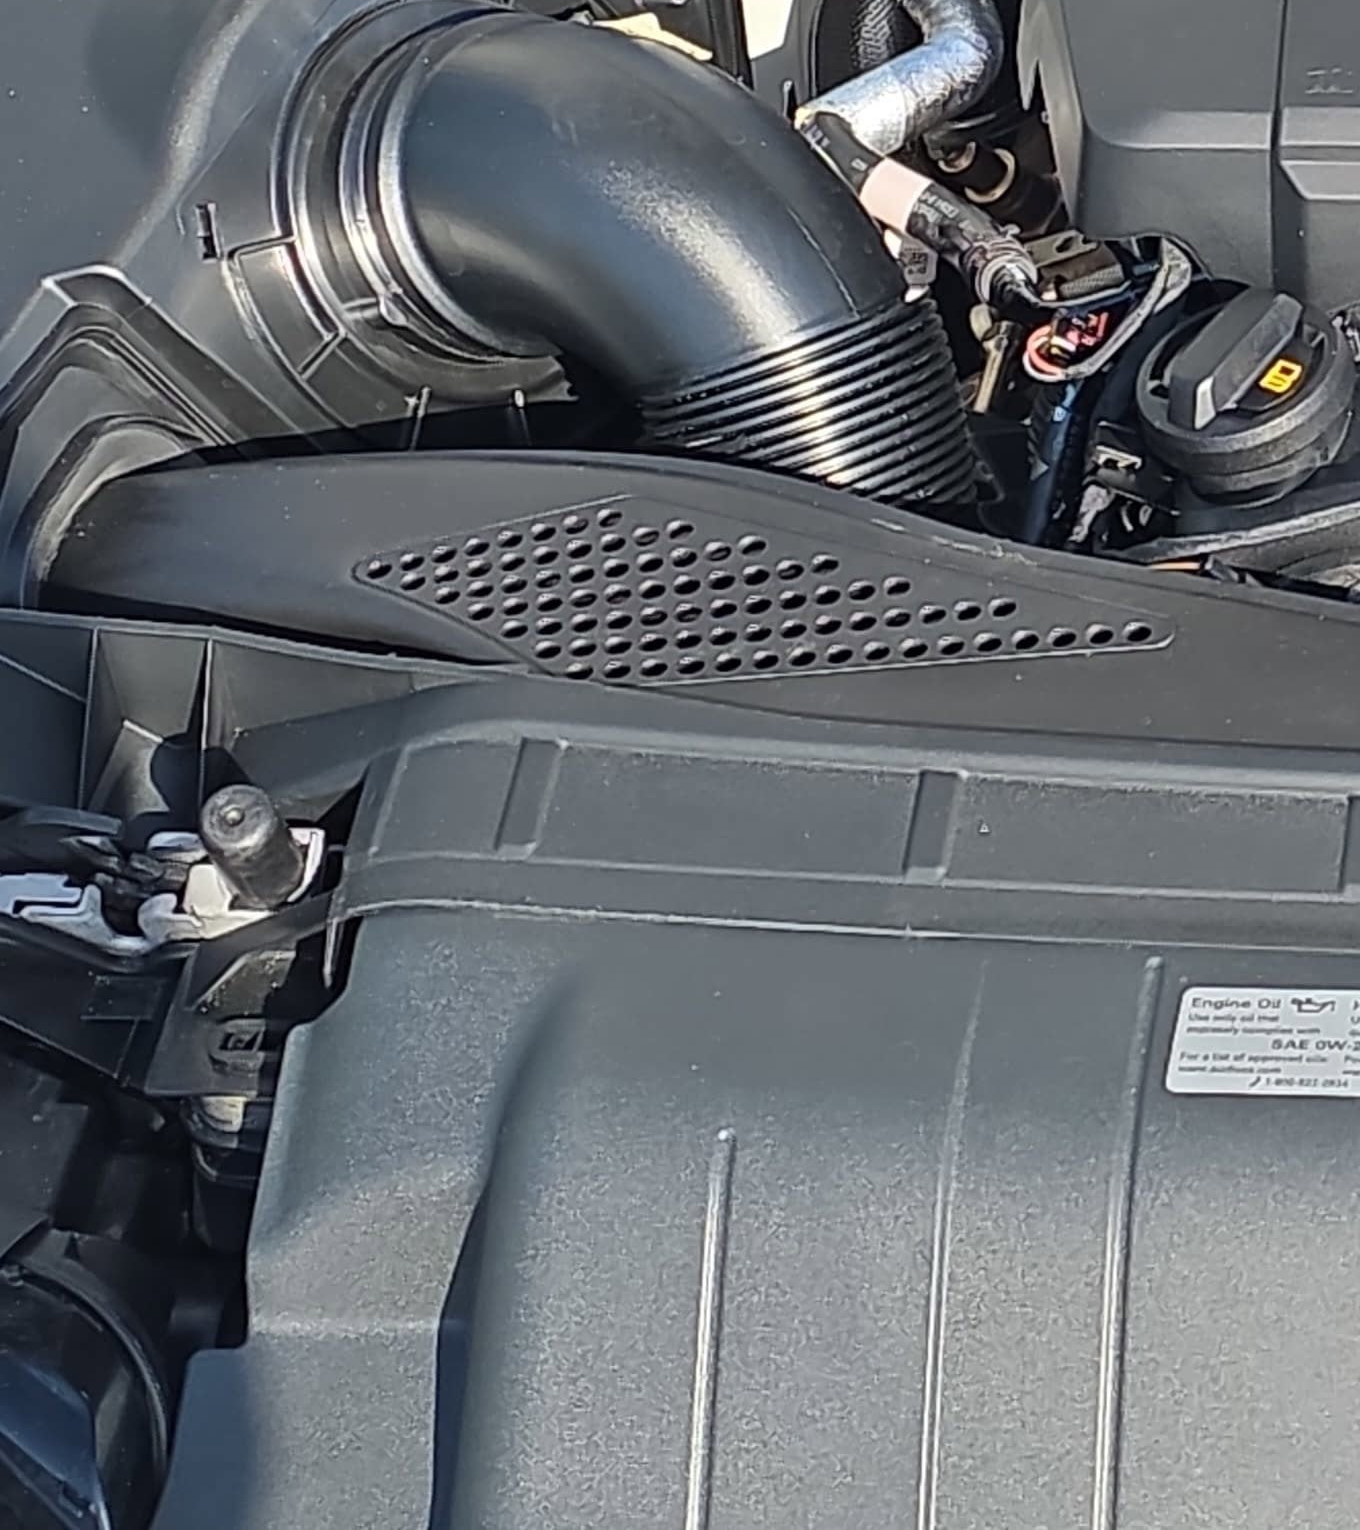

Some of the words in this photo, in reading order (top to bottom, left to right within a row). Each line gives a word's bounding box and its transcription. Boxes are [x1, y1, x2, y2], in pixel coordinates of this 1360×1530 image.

[1191, 997, 1251, 1011] Engine
[1257, 997, 1282, 1010] Oil
[1271, 1039, 1310, 1051] SAE
